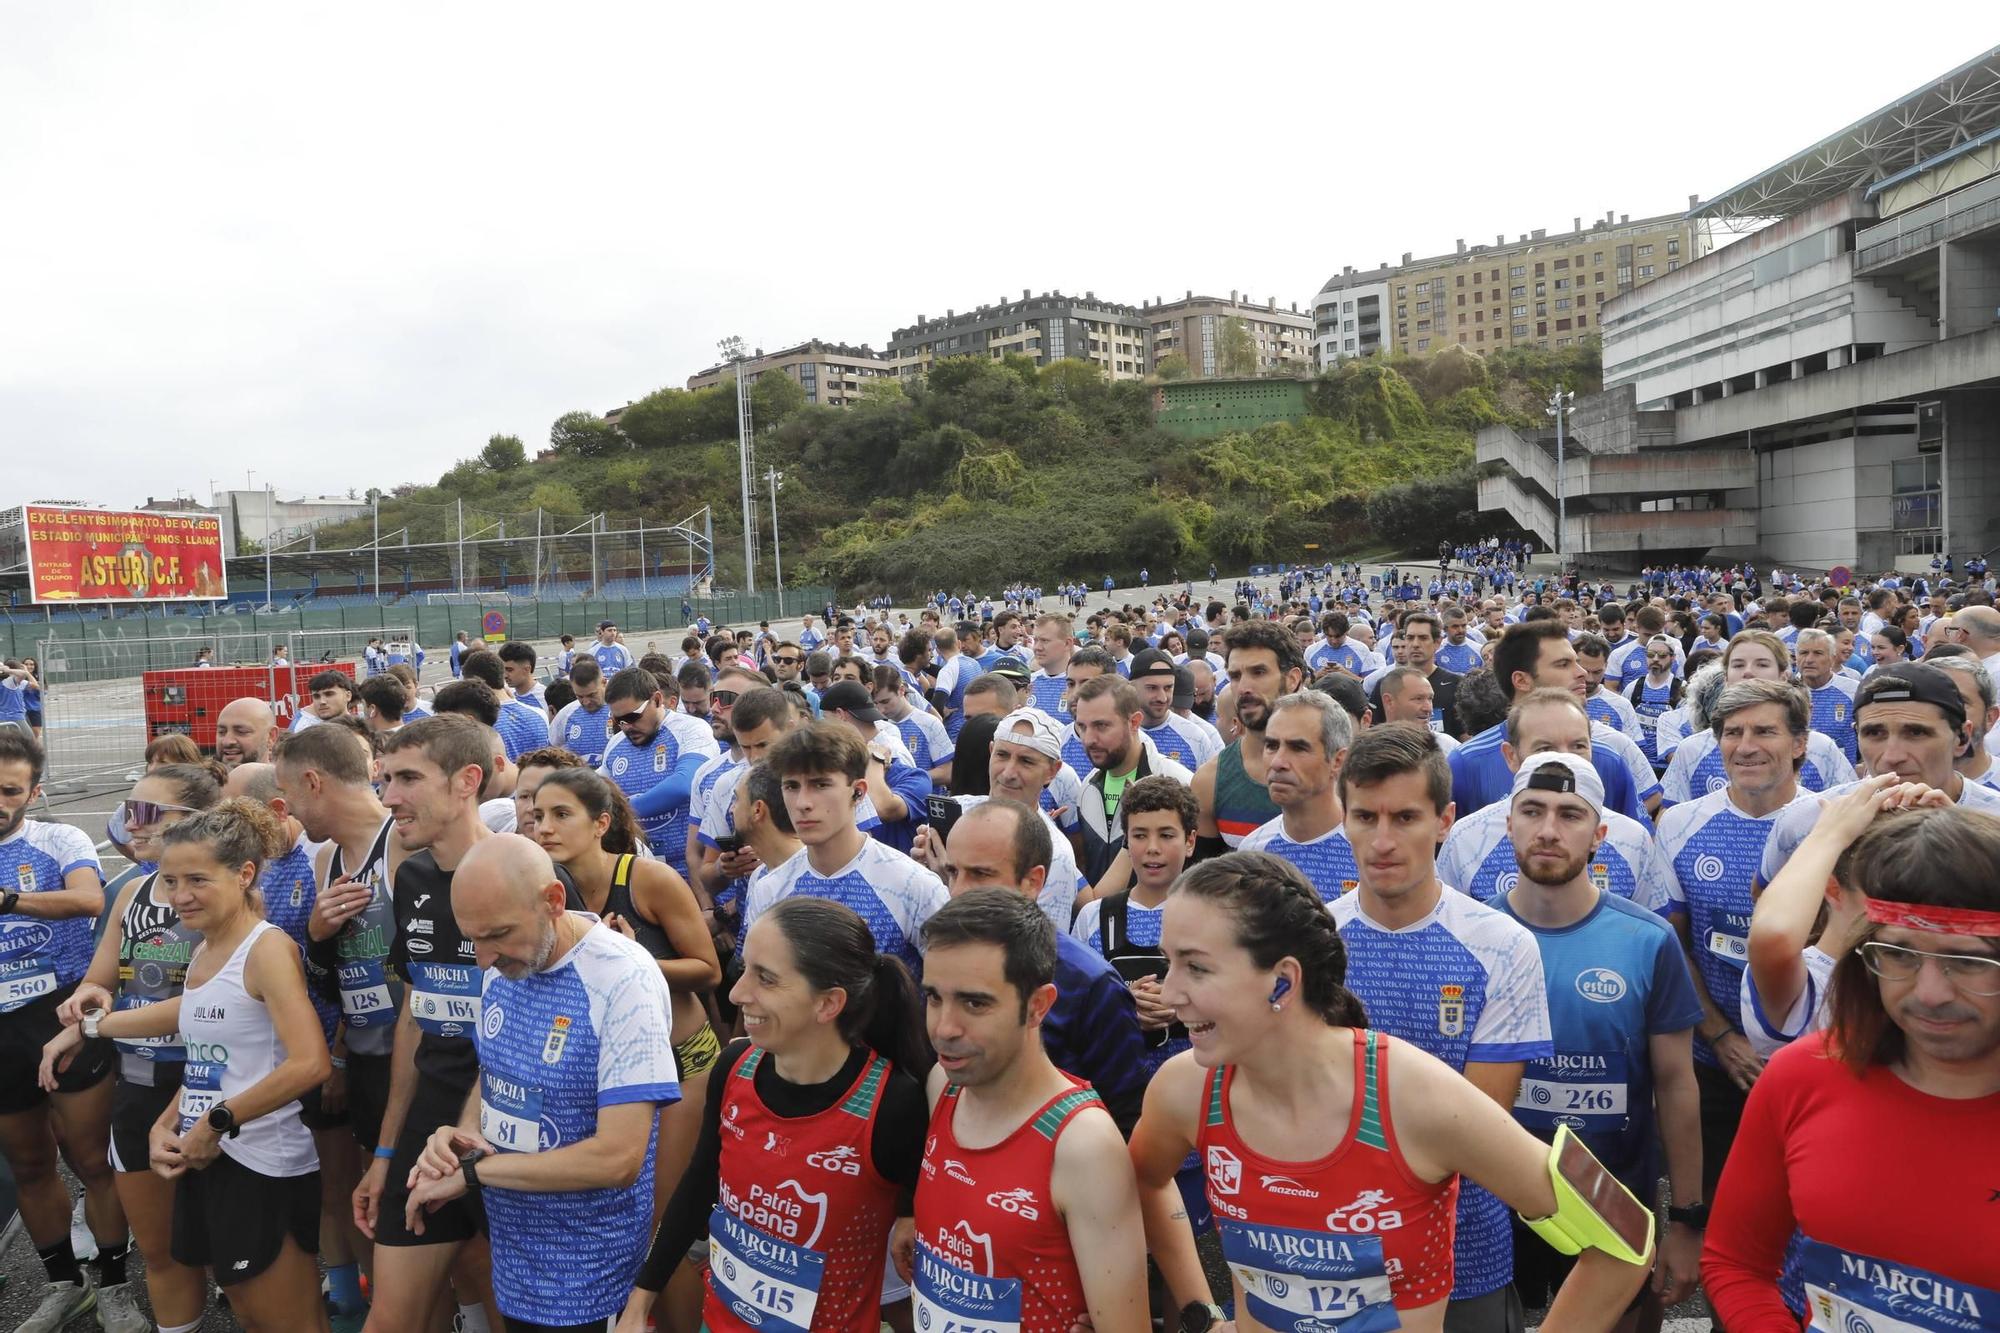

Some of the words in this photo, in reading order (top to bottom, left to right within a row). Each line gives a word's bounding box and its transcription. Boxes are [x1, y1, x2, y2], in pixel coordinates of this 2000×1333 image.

[31, 530, 83, 543] ESTADIO
[164, 518, 179, 529] DE
[38, 561, 73, 569] ENTRADA
[39, 574, 73, 582] EQUIPOS
[153, 555, 184, 586] C.F.
[424, 965, 470, 983] MARCHA
[9, 978, 48, 998] 560
[351, 991, 381, 1011] 128
[193, 1004, 225, 1020] JULIÁN
[445, 1000, 476, 1019] 164
[185, 1033, 229, 1064] hco
[1565, 1088, 1614, 1111] 246
[497, 1119, 517, 1145] 81
[749, 1183, 803, 1219] Patria
[1268, 1185, 1320, 1199] mazcatu
[718, 1176, 799, 1239] Hispana
[724, 1216, 800, 1268] MARCHA
[938, 1226, 974, 1259] Patria
[1246, 1229, 1354, 1263] MARCHA
[1274, 1252, 1358, 1274] Centenario
[920, 1254, 995, 1302] MARCHA
[1840, 1253, 1982, 1319] MARCHA
[750, 1279, 796, 1314] 415
[1308, 1285, 1368, 1313] 124
[1874, 1285, 1982, 1331] Centenario
